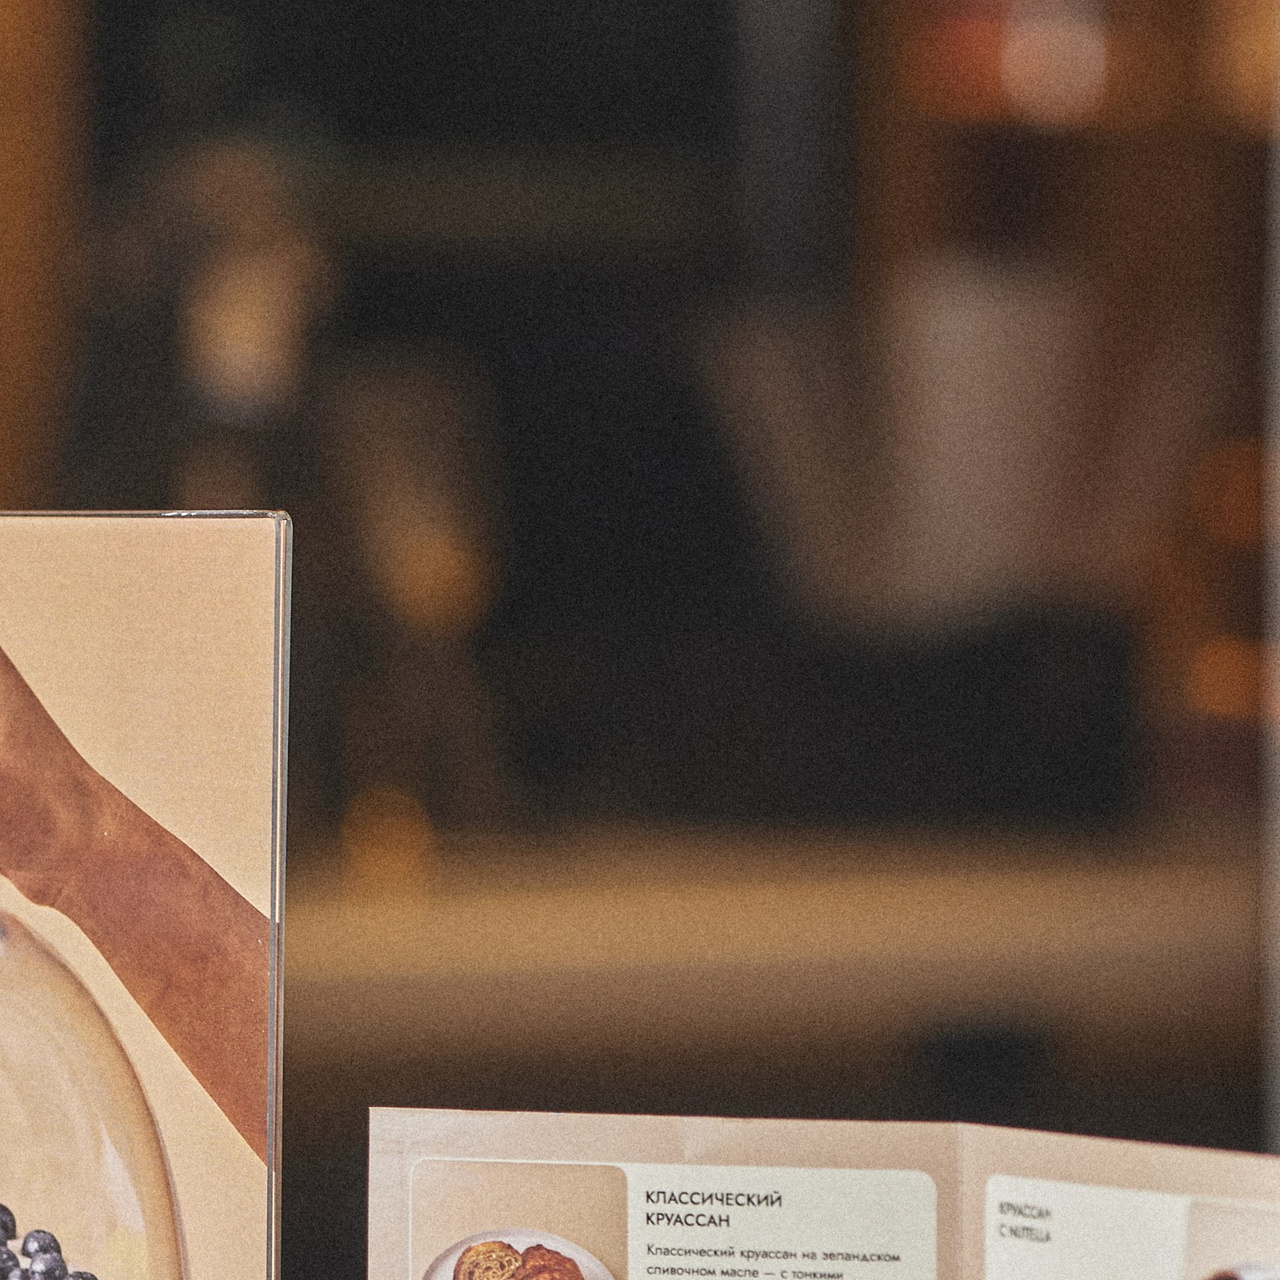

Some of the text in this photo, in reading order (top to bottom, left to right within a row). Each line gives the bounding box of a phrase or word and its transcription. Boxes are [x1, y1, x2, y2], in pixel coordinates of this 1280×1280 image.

[645, 1190, 782, 1207] КЛАССИЧЕСКИЙ
[645, 1212, 730, 1228] КРУАССАН
[647, 1244, 901, 1262] Классический круассан на зеландском
[646, 1266, 843, 1280] сливочном масле с тонкими
